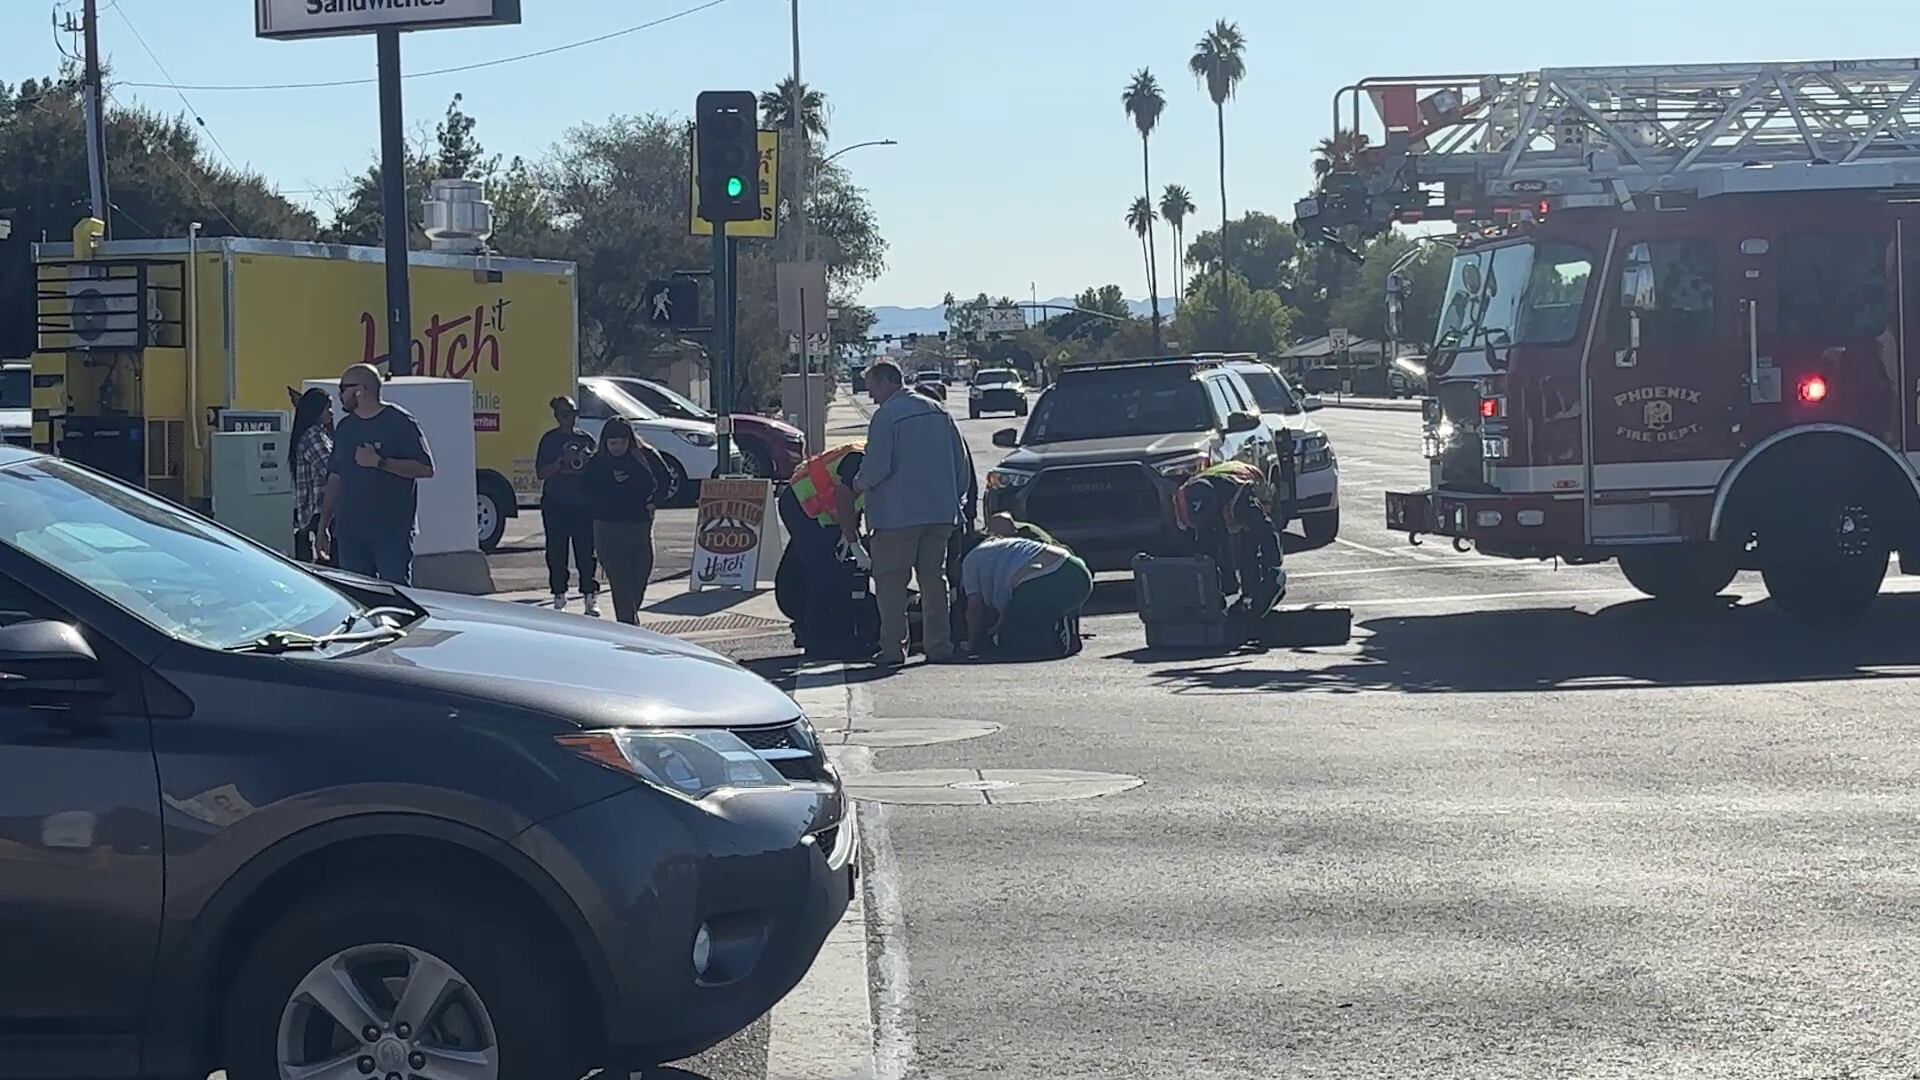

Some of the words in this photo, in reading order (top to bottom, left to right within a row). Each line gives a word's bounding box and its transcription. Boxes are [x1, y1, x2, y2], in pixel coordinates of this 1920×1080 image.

[473, 390, 500, 410] hile
[1614, 386, 1702, 407] PHOENIX
[234, 422, 272, 432] RANCH
[1616, 426, 1653, 442] FIRE
[1071, 482, 1113, 493] TOYOTA
[705, 532, 751, 548] FOOD
